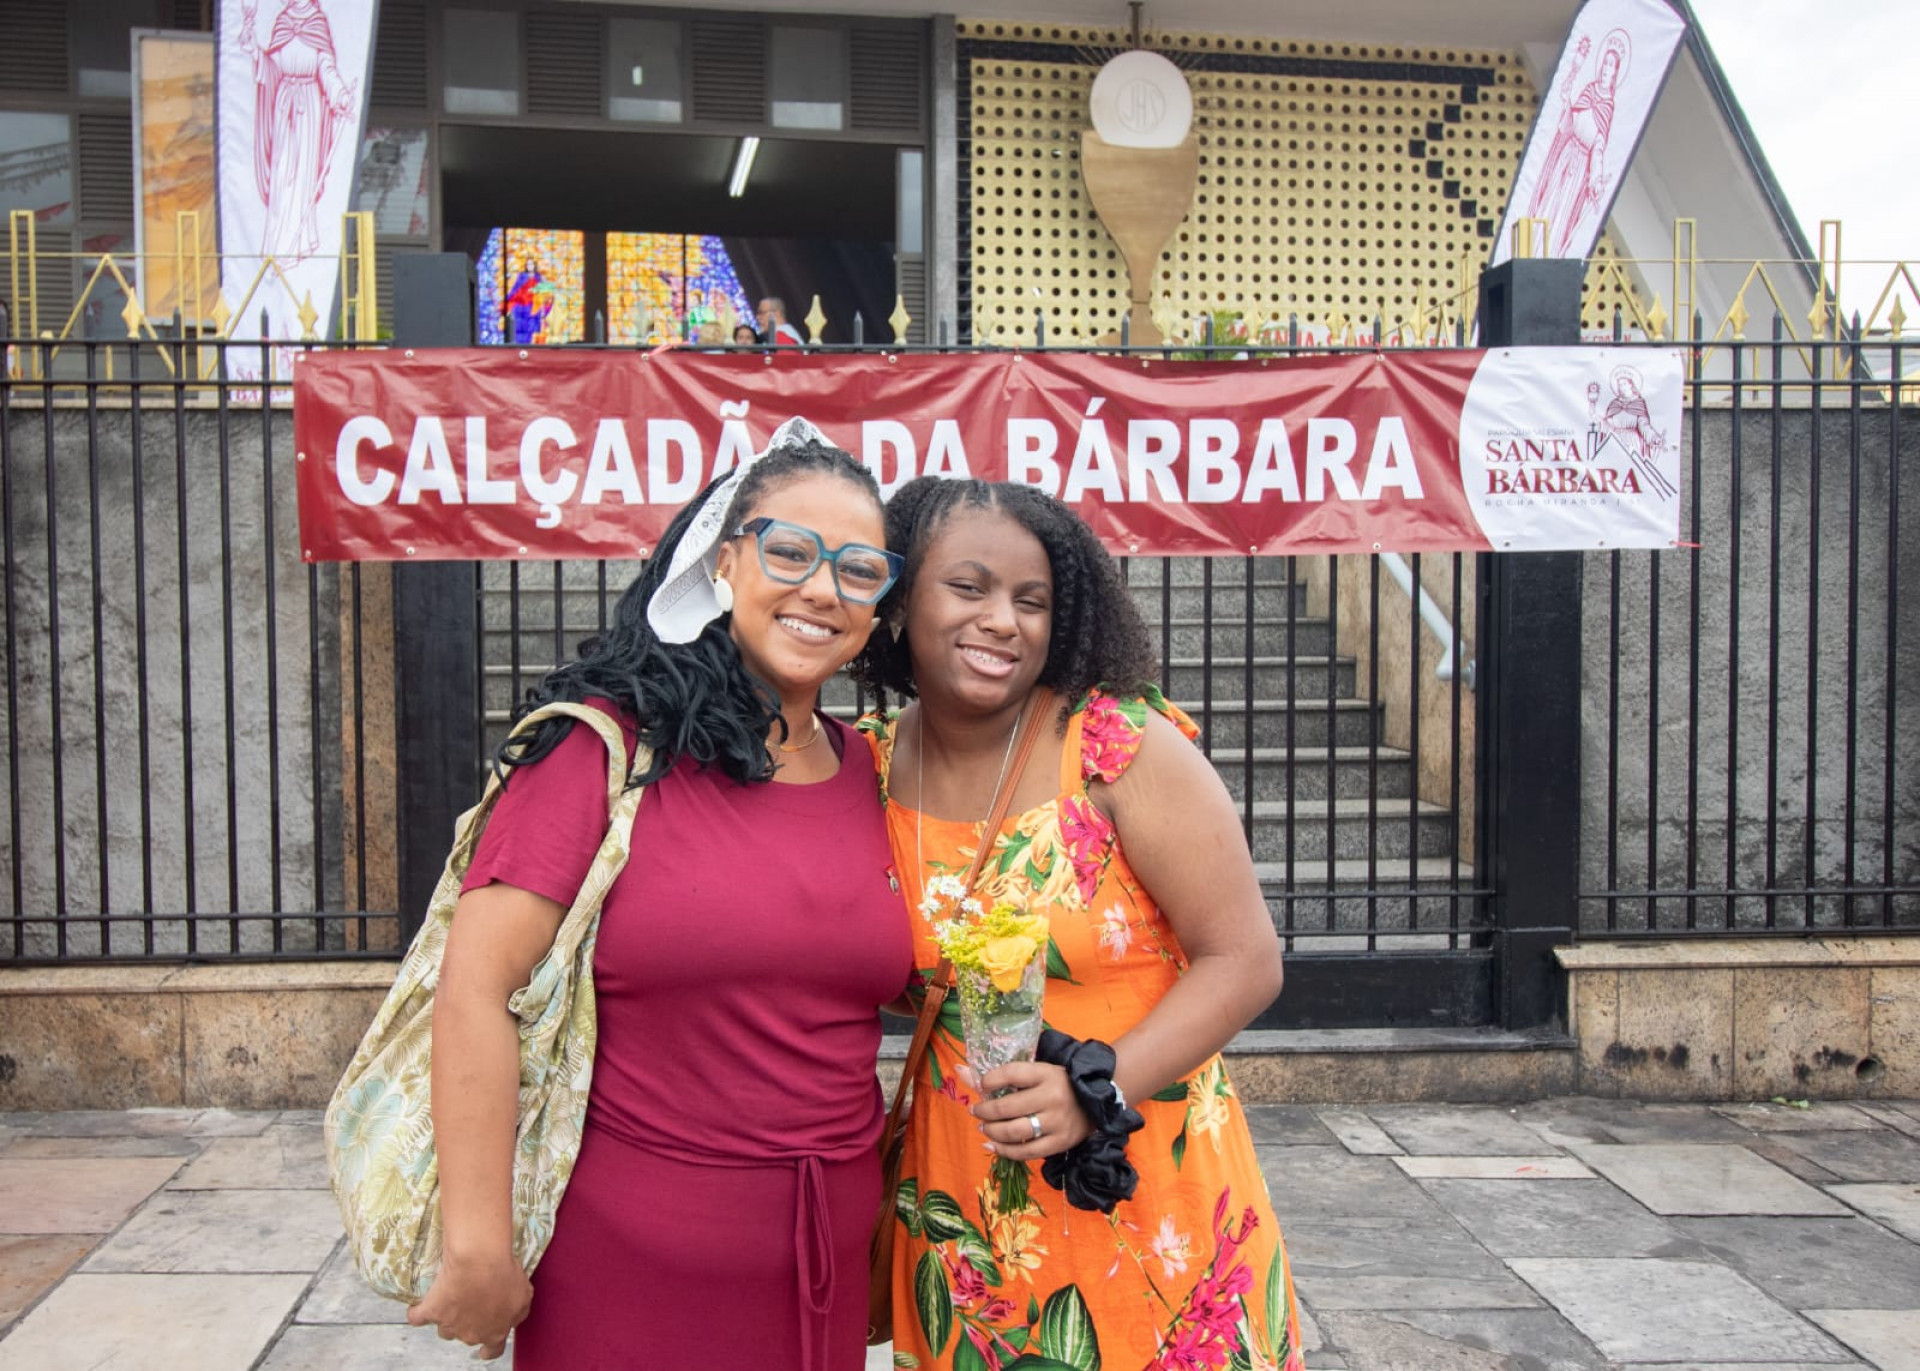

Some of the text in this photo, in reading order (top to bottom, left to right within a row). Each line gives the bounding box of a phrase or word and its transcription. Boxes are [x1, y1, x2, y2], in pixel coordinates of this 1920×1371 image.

[335, 397, 1424, 528] CALÇADÃ DA BÁRBARA
[1485, 438, 1583, 463] SANTA
[1485, 463, 1642, 494] BÁRBARA
